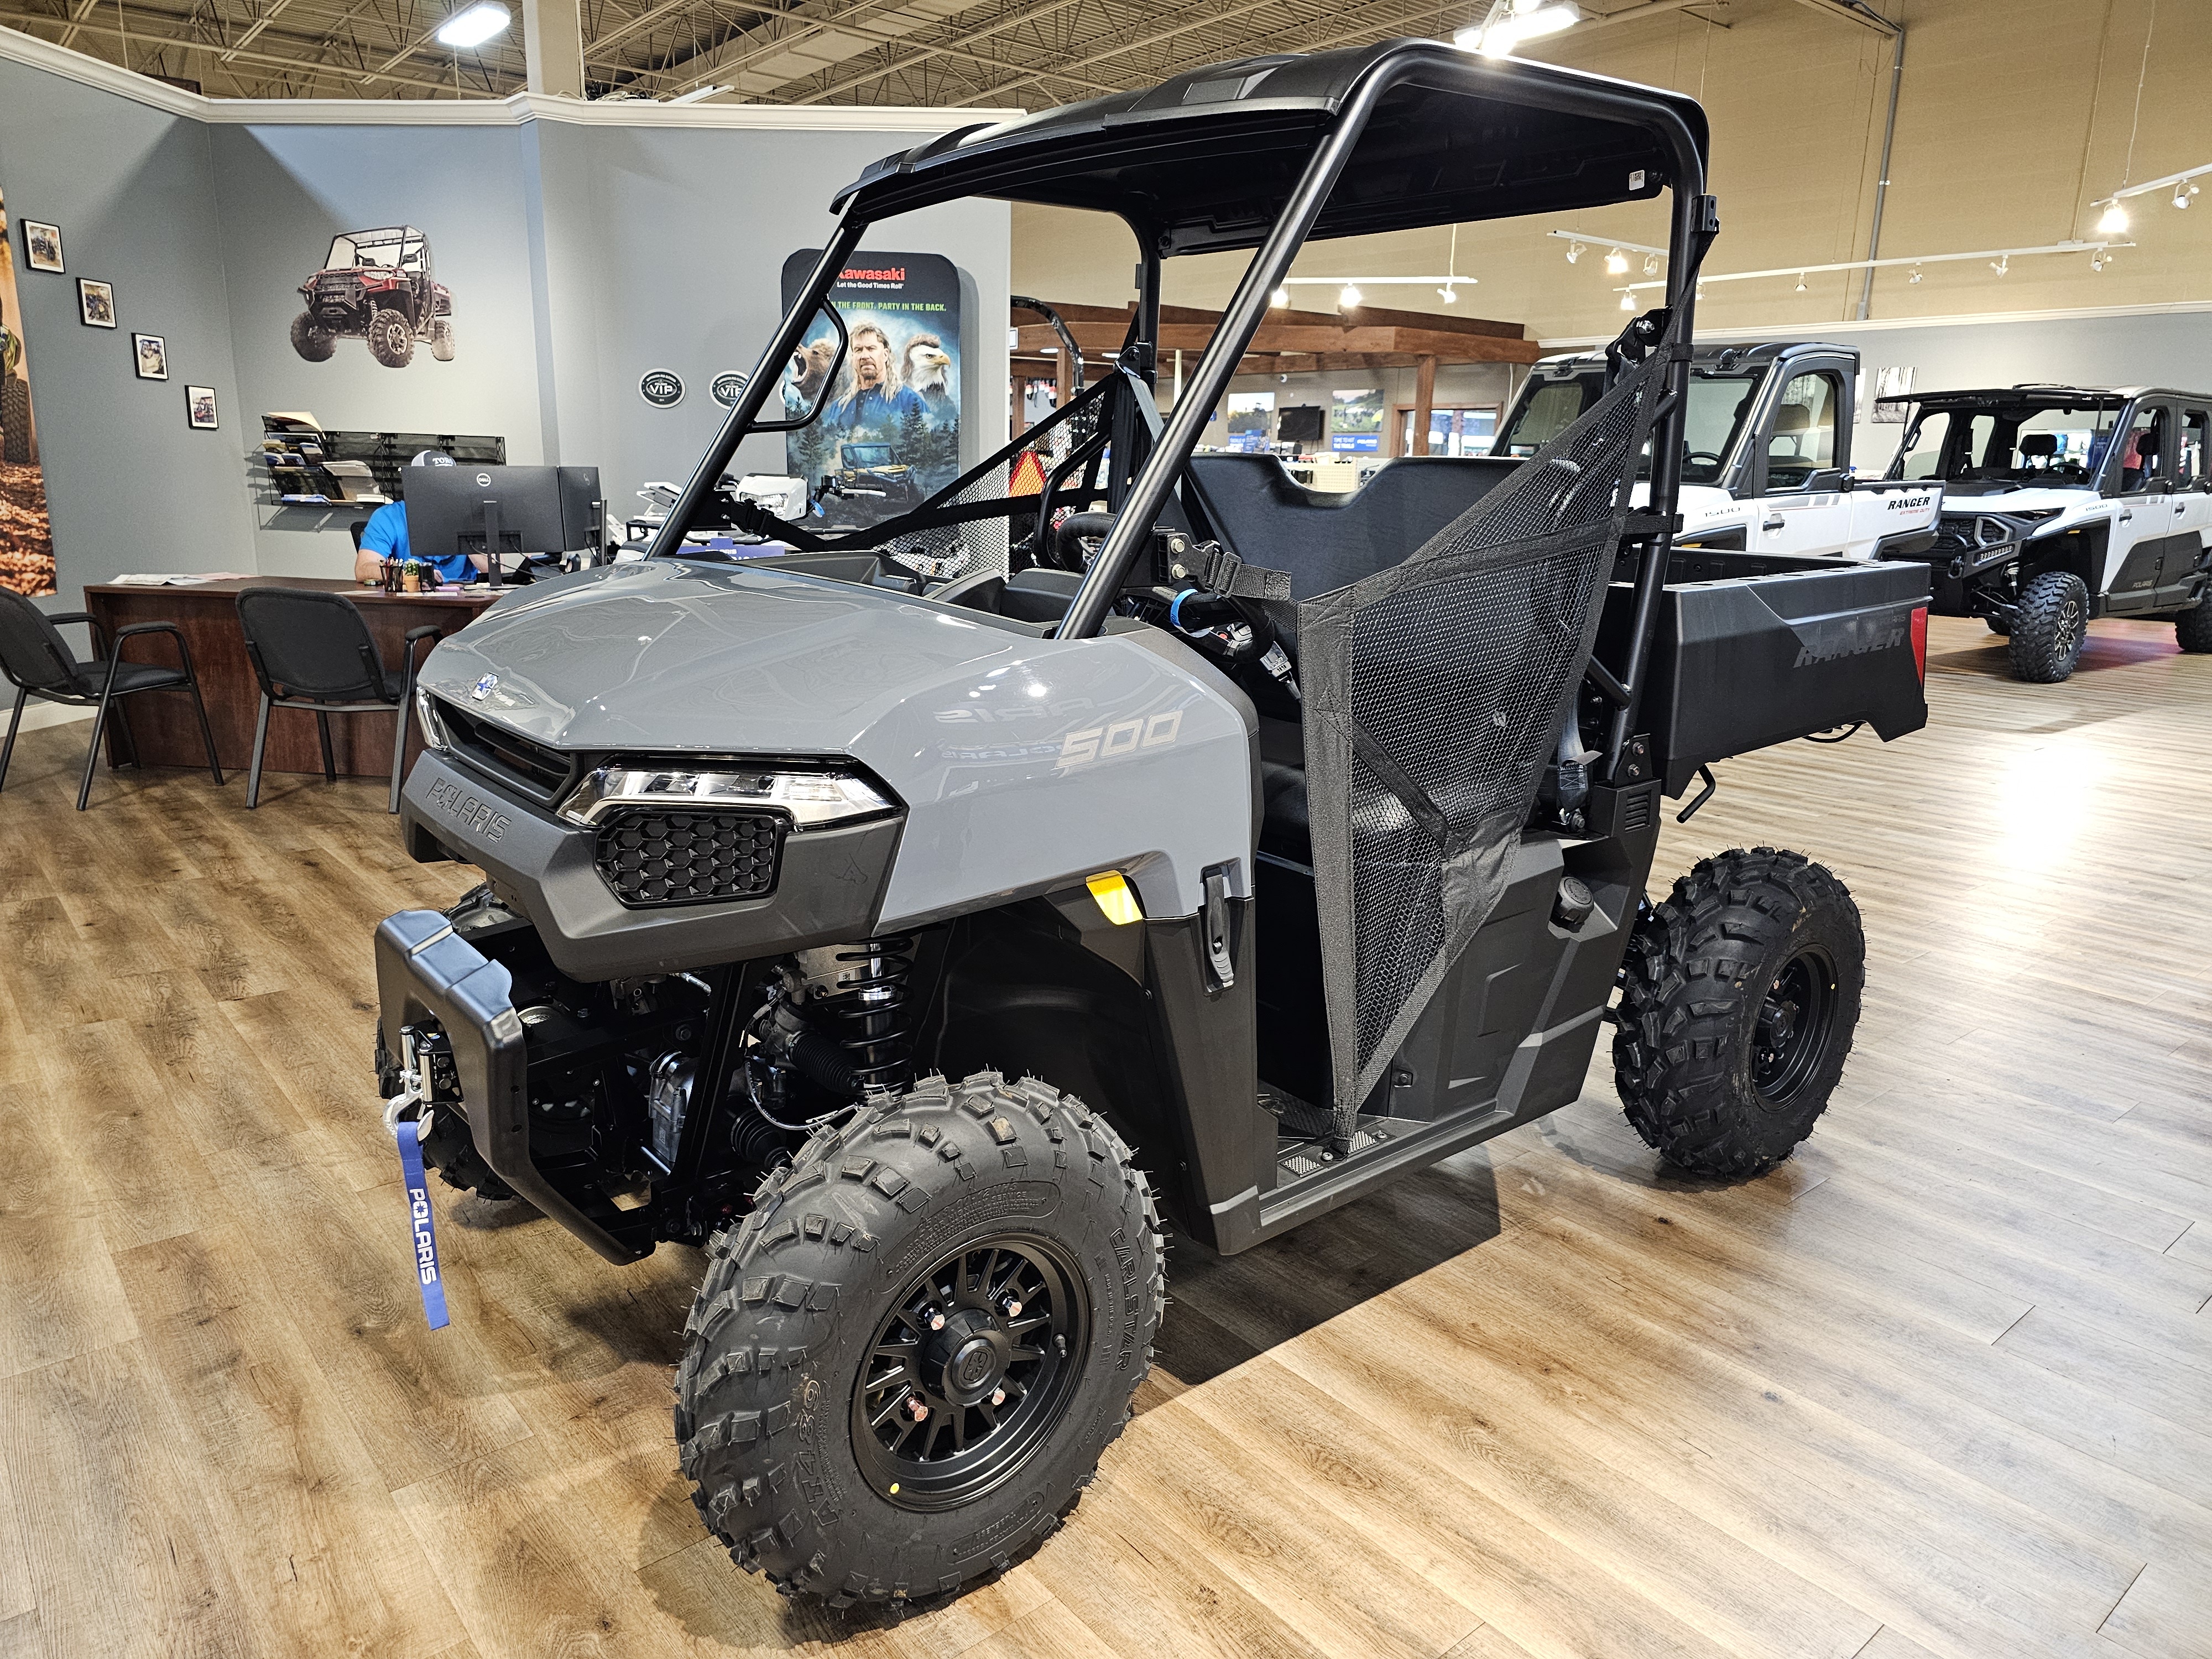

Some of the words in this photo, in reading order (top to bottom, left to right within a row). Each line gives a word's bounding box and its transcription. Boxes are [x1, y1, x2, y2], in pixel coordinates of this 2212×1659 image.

[650, 384, 673, 394] VIP
[1887, 497, 1930, 510] RANGER
[2132, 580, 2153, 588] POLARIS
[1793, 627, 1905, 668] RANGER
[1055, 709, 1183, 769] 500
[425, 778, 512, 844] POLARIS
[990, 1191, 1027, 1203] SERVICE
[410, 1188, 437, 1285] POLARIS
[1109, 1227, 1139, 1371] CARLSTAR
